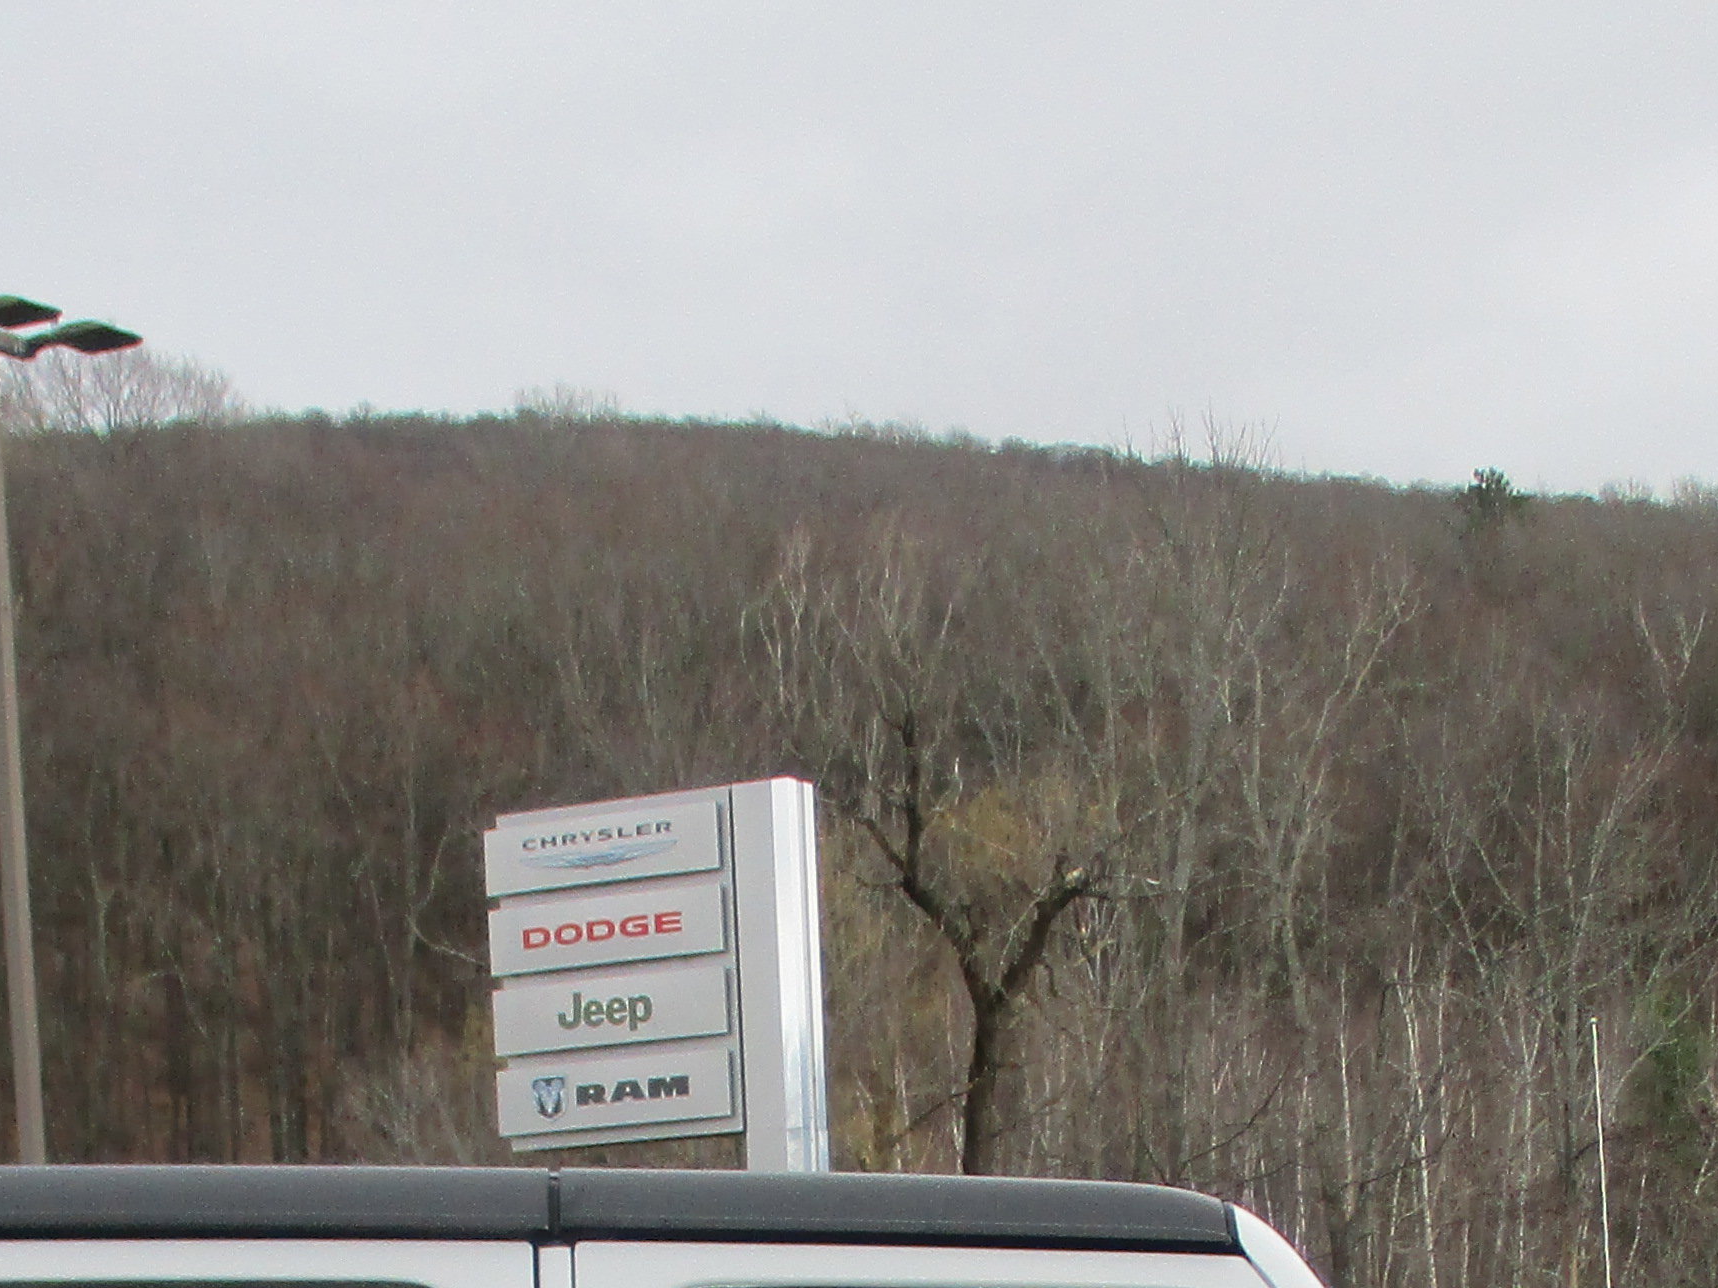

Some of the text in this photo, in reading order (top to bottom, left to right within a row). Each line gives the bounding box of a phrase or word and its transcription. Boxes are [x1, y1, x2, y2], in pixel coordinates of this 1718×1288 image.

[521, 820, 673, 851] CHRYSLER
[522, 911, 683, 950] DODGE
[558, 991, 653, 1031] Jeep
[575, 1075, 690, 1106] RAM
